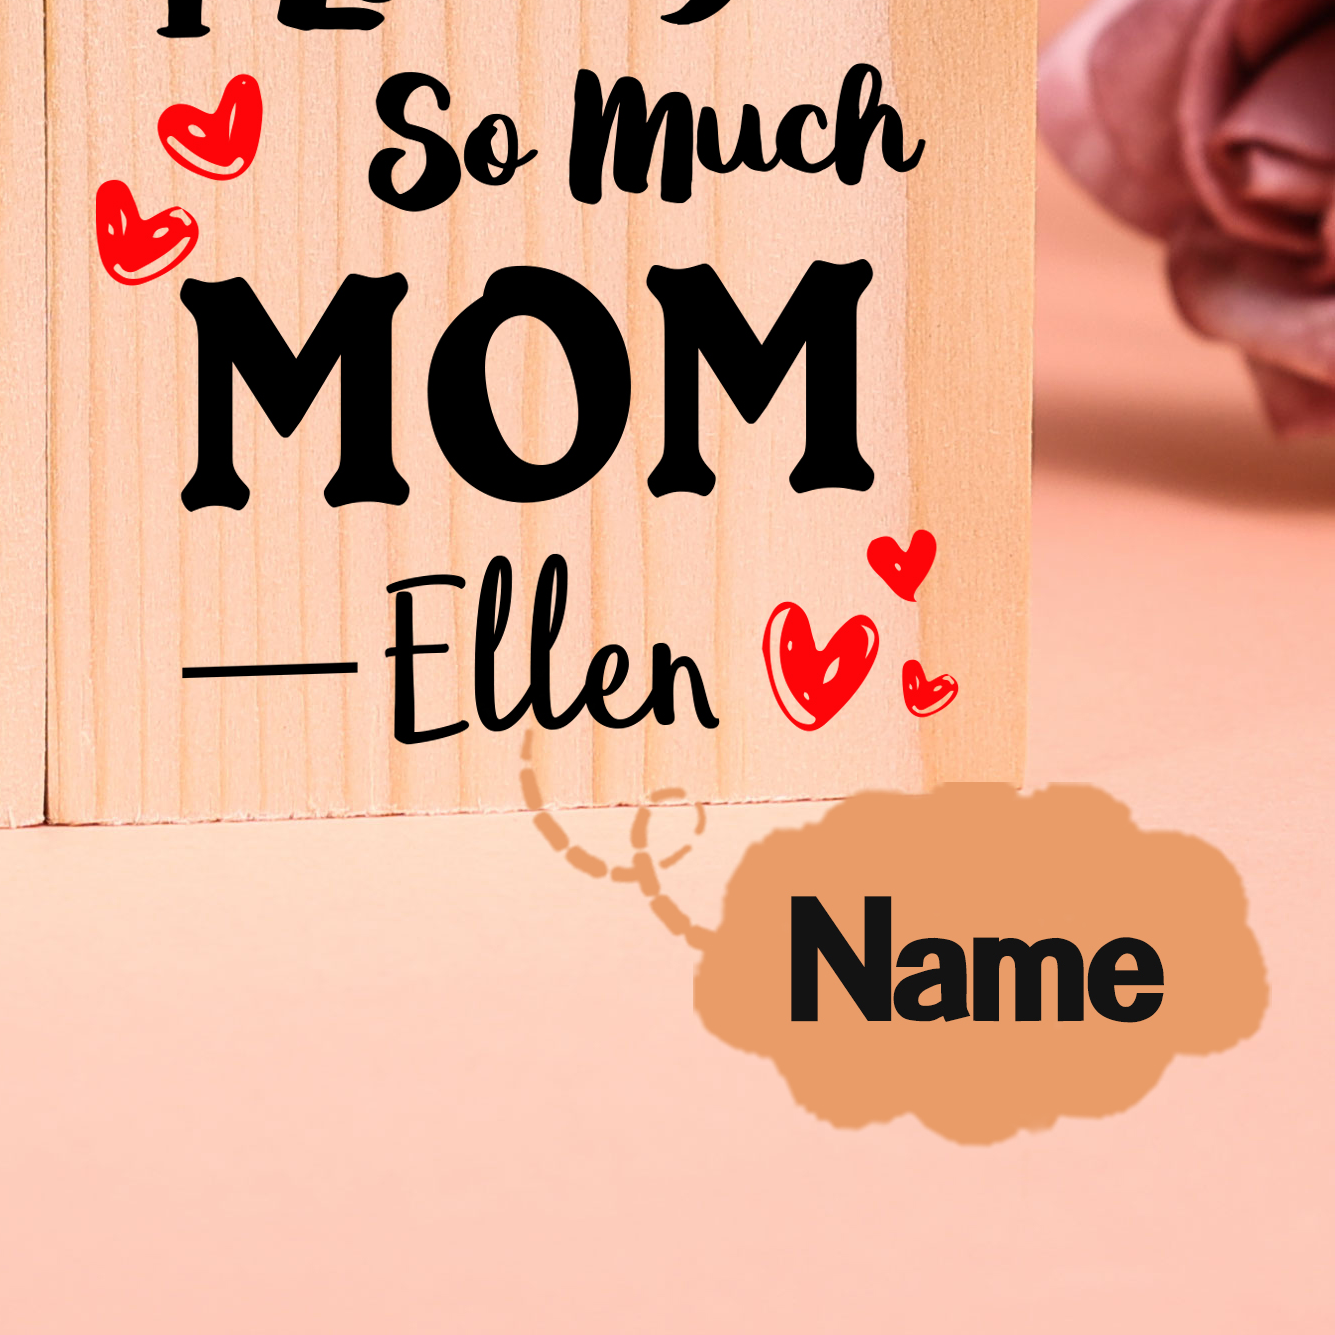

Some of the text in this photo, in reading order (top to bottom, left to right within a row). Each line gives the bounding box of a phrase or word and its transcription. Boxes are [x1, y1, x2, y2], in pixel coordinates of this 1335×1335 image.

[368, 63, 926, 212] So Much
[179, 258, 875, 513] MOM
